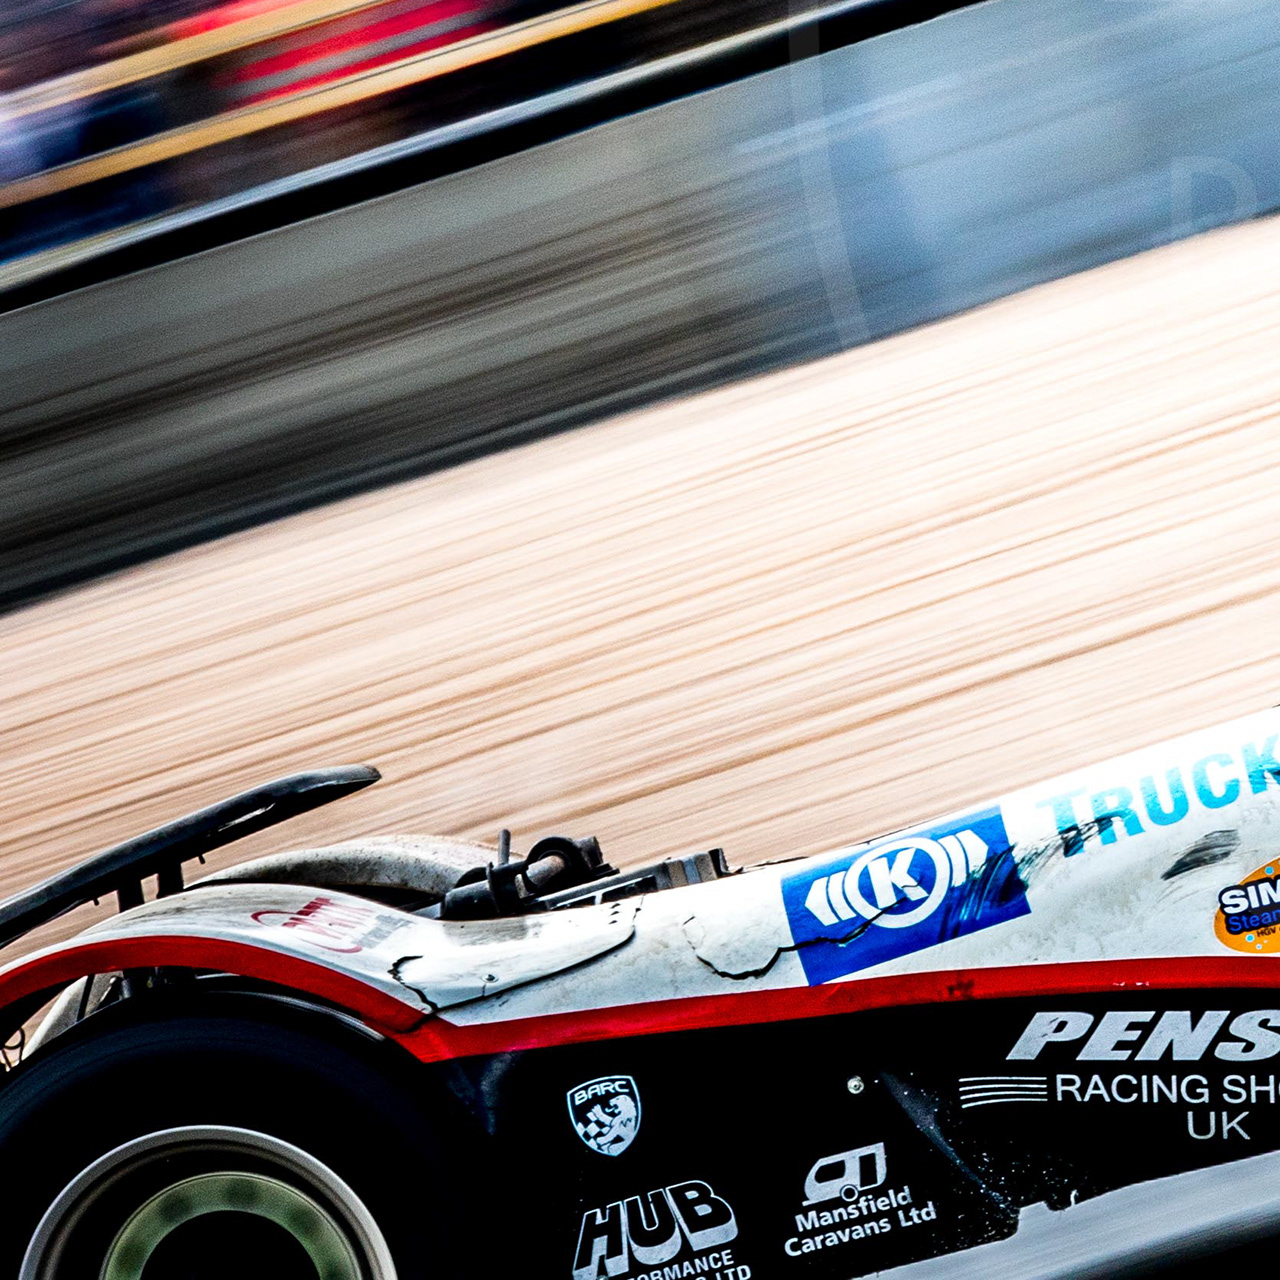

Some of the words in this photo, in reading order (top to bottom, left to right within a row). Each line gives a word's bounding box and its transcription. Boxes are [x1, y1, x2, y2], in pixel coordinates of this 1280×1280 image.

[1256, 926, 1277, 937] HGV
[574, 1080, 630, 1106] BARC
[1056, 1074, 1210, 1104] RACING
[1187, 1111, 1251, 1141] UK
[794, 1185, 913, 1232] Mansfield
[572, 1180, 739, 1280] HUB
[783, 1217, 892, 1257] Caravans
[899, 1201, 938, 1229] Ltd
